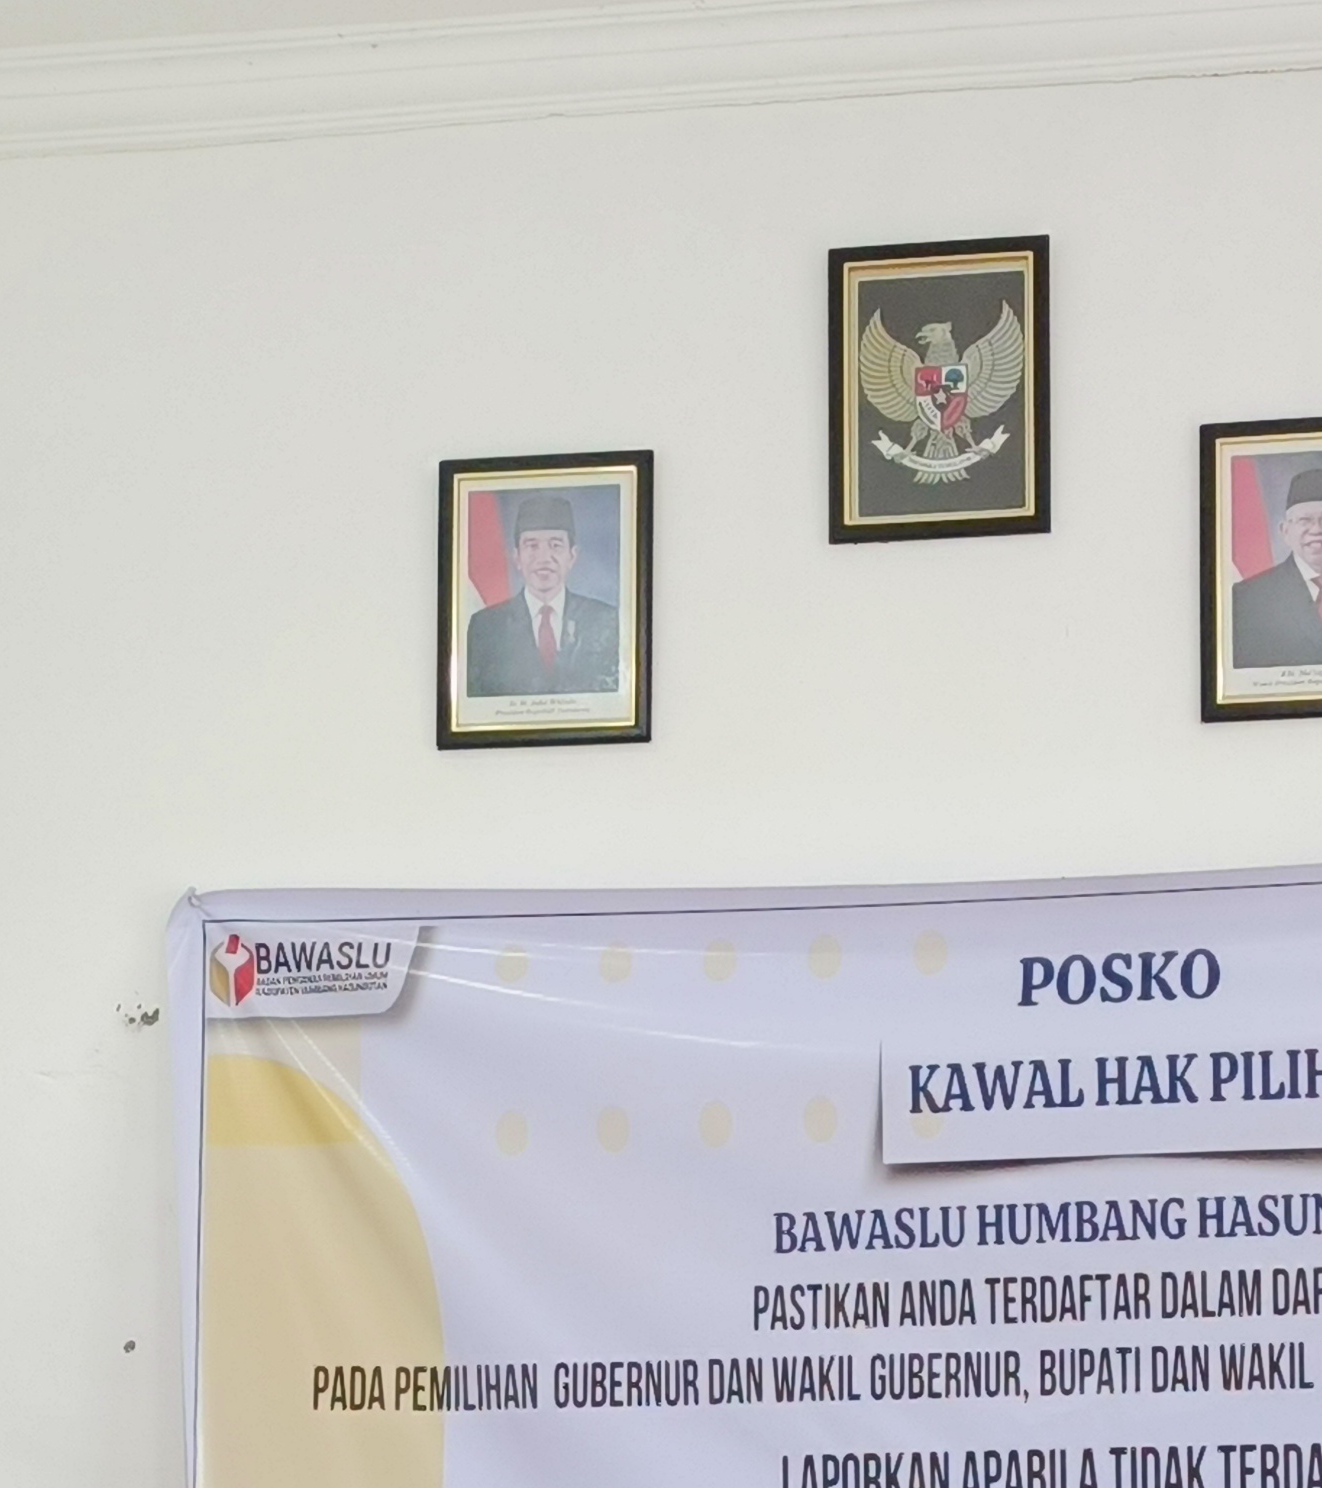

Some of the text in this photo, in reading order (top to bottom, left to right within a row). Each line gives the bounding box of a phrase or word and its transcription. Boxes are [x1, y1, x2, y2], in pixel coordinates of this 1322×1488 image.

[255, 941, 391, 974] BAWASLU
[1017, 948, 1221, 1006] POSKO
[908, 1058, 1084, 1113] KAWAL
[1094, 1053, 1198, 1106] HAK
[773, 1205, 966, 1254] BAWASLU
[977, 1198, 1188, 1246] HUMBANG
[752, 1281, 890, 1331] PASTIKAN
[899, 1278, 977, 1326] ANDA
[984, 1272, 1151, 1325] TERDAFTAR
[1161, 1268, 1262, 1319] DALAM
[313, 1365, 385, 1411] PADA
[394, 1362, 538, 1411] PEMILIHAN
[553, 1359, 700, 1410] GUBERNUR
[708, 1357, 763, 1405] DAN
[772, 1354, 861, 1404] WAKIL
[869, 1349, 1030, 1404] GUBERNUR,
[1039, 1345, 1141, 1397] BUPATI
[1152, 1344, 1209, 1394] DAN
[1220, 1341, 1314, 1391] WAKIL
